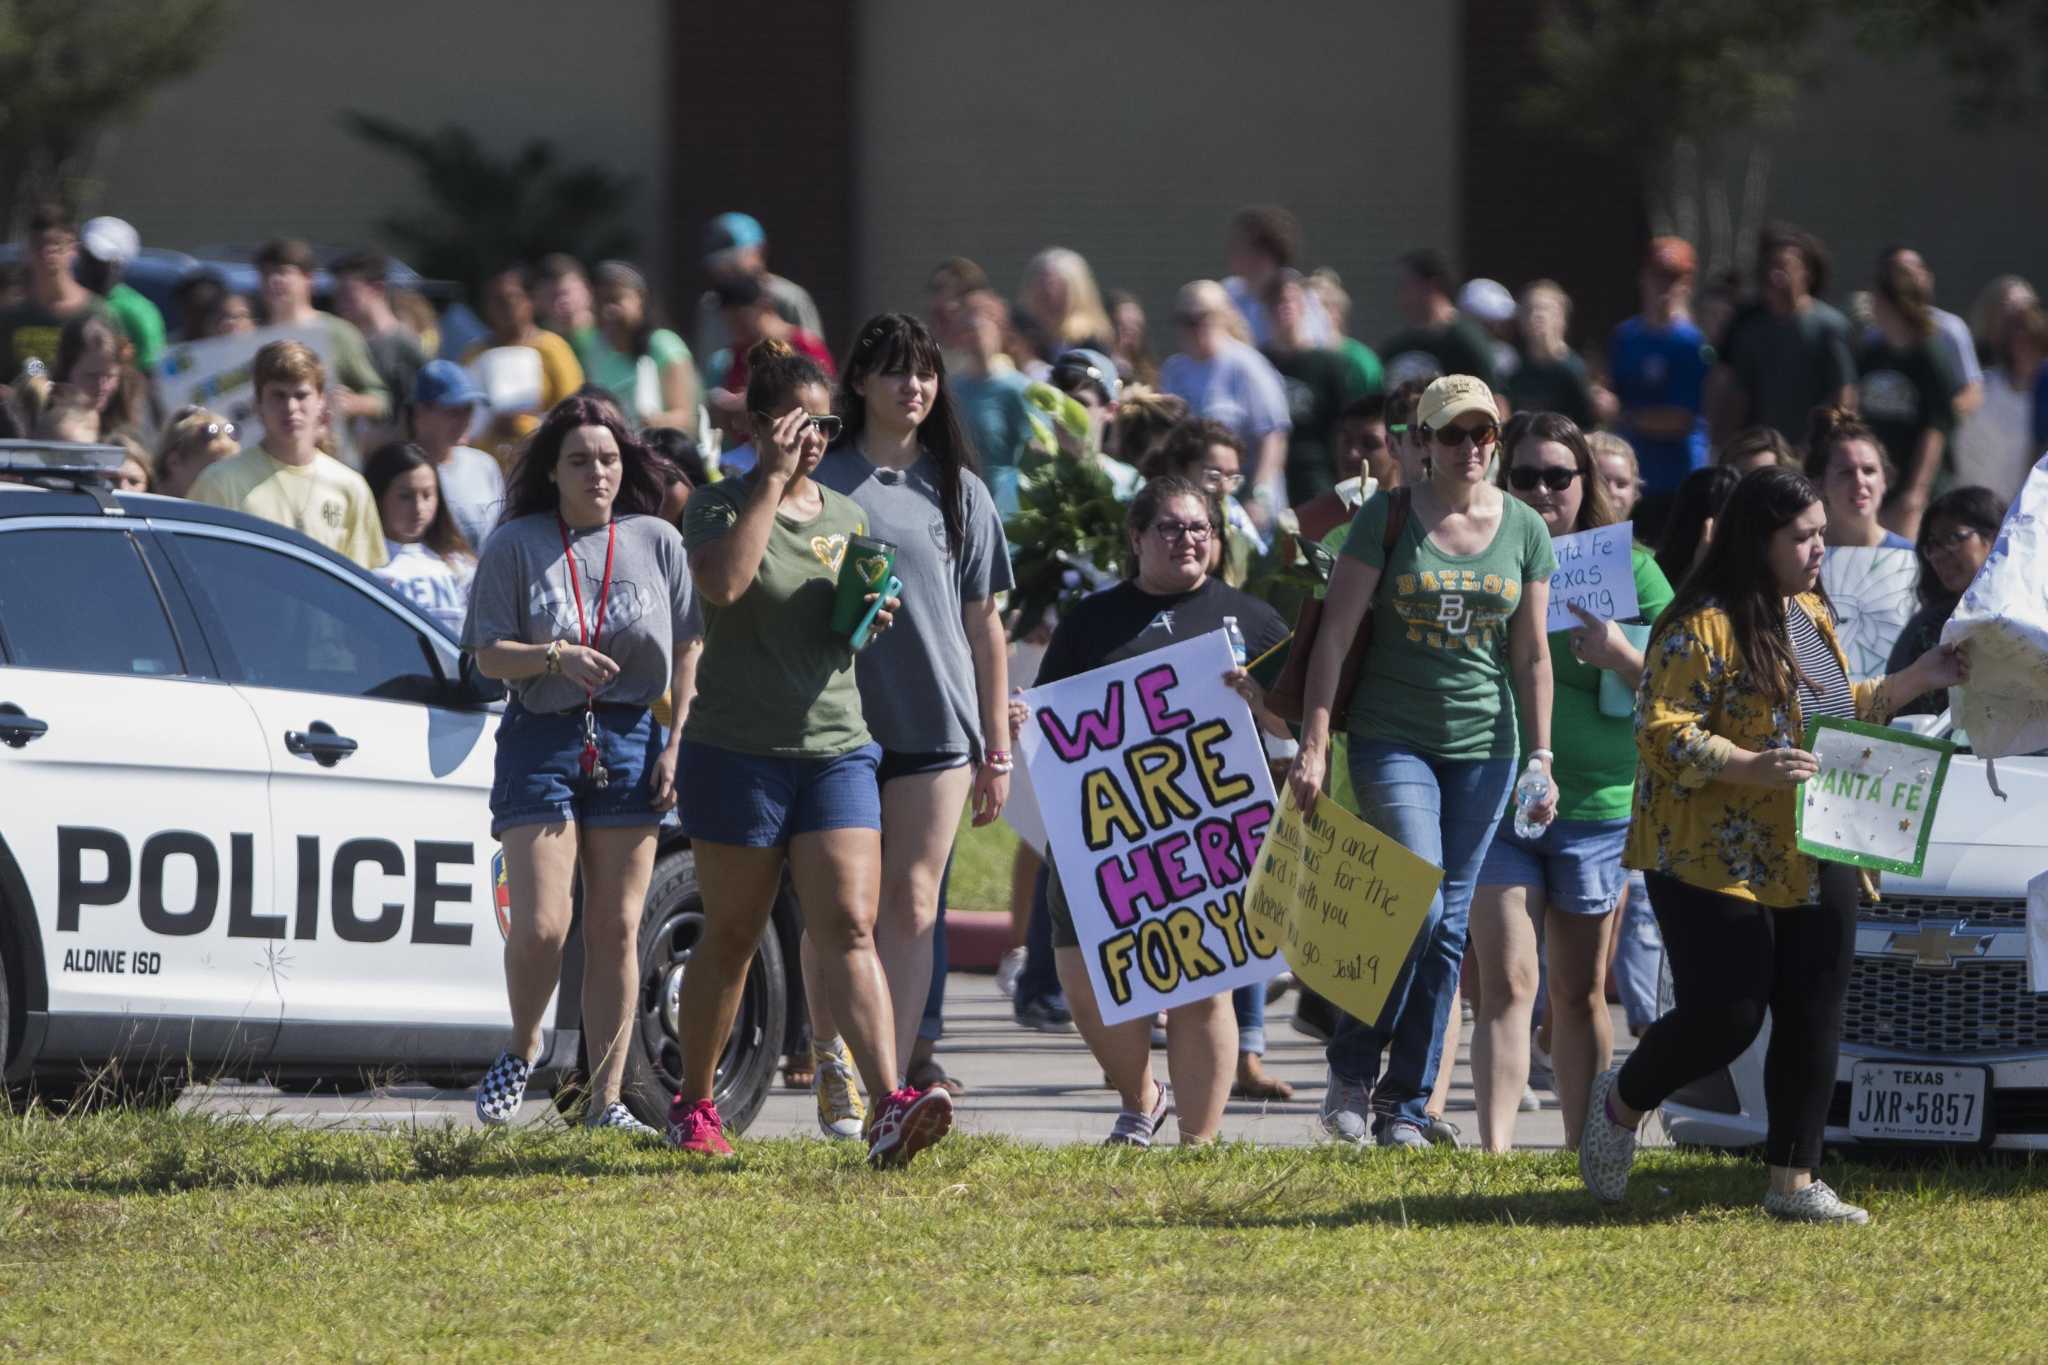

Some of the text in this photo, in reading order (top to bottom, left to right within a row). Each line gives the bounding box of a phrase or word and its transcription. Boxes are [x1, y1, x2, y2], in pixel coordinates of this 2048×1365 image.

[1591, 530, 1614, 556] Fe
[1396, 569, 1520, 601] BAYLOR
[1550, 564, 1602, 590] exas
[1547, 588, 1615, 618] trong
[1037, 663, 1196, 764] WE
[1080, 717, 1255, 853] ARE
[1809, 767, 1922, 812] SANTA FE
[1341, 837, 1380, 873] and
[56, 824, 475, 946] POLICE
[1334, 861, 1361, 892] for
[1322, 900, 1349, 930] you
[63, 948, 162, 976] ALDINE ISD
[1893, 1070, 1945, 1086] TEXAS
[1914, 1091, 1976, 1127] 5857
